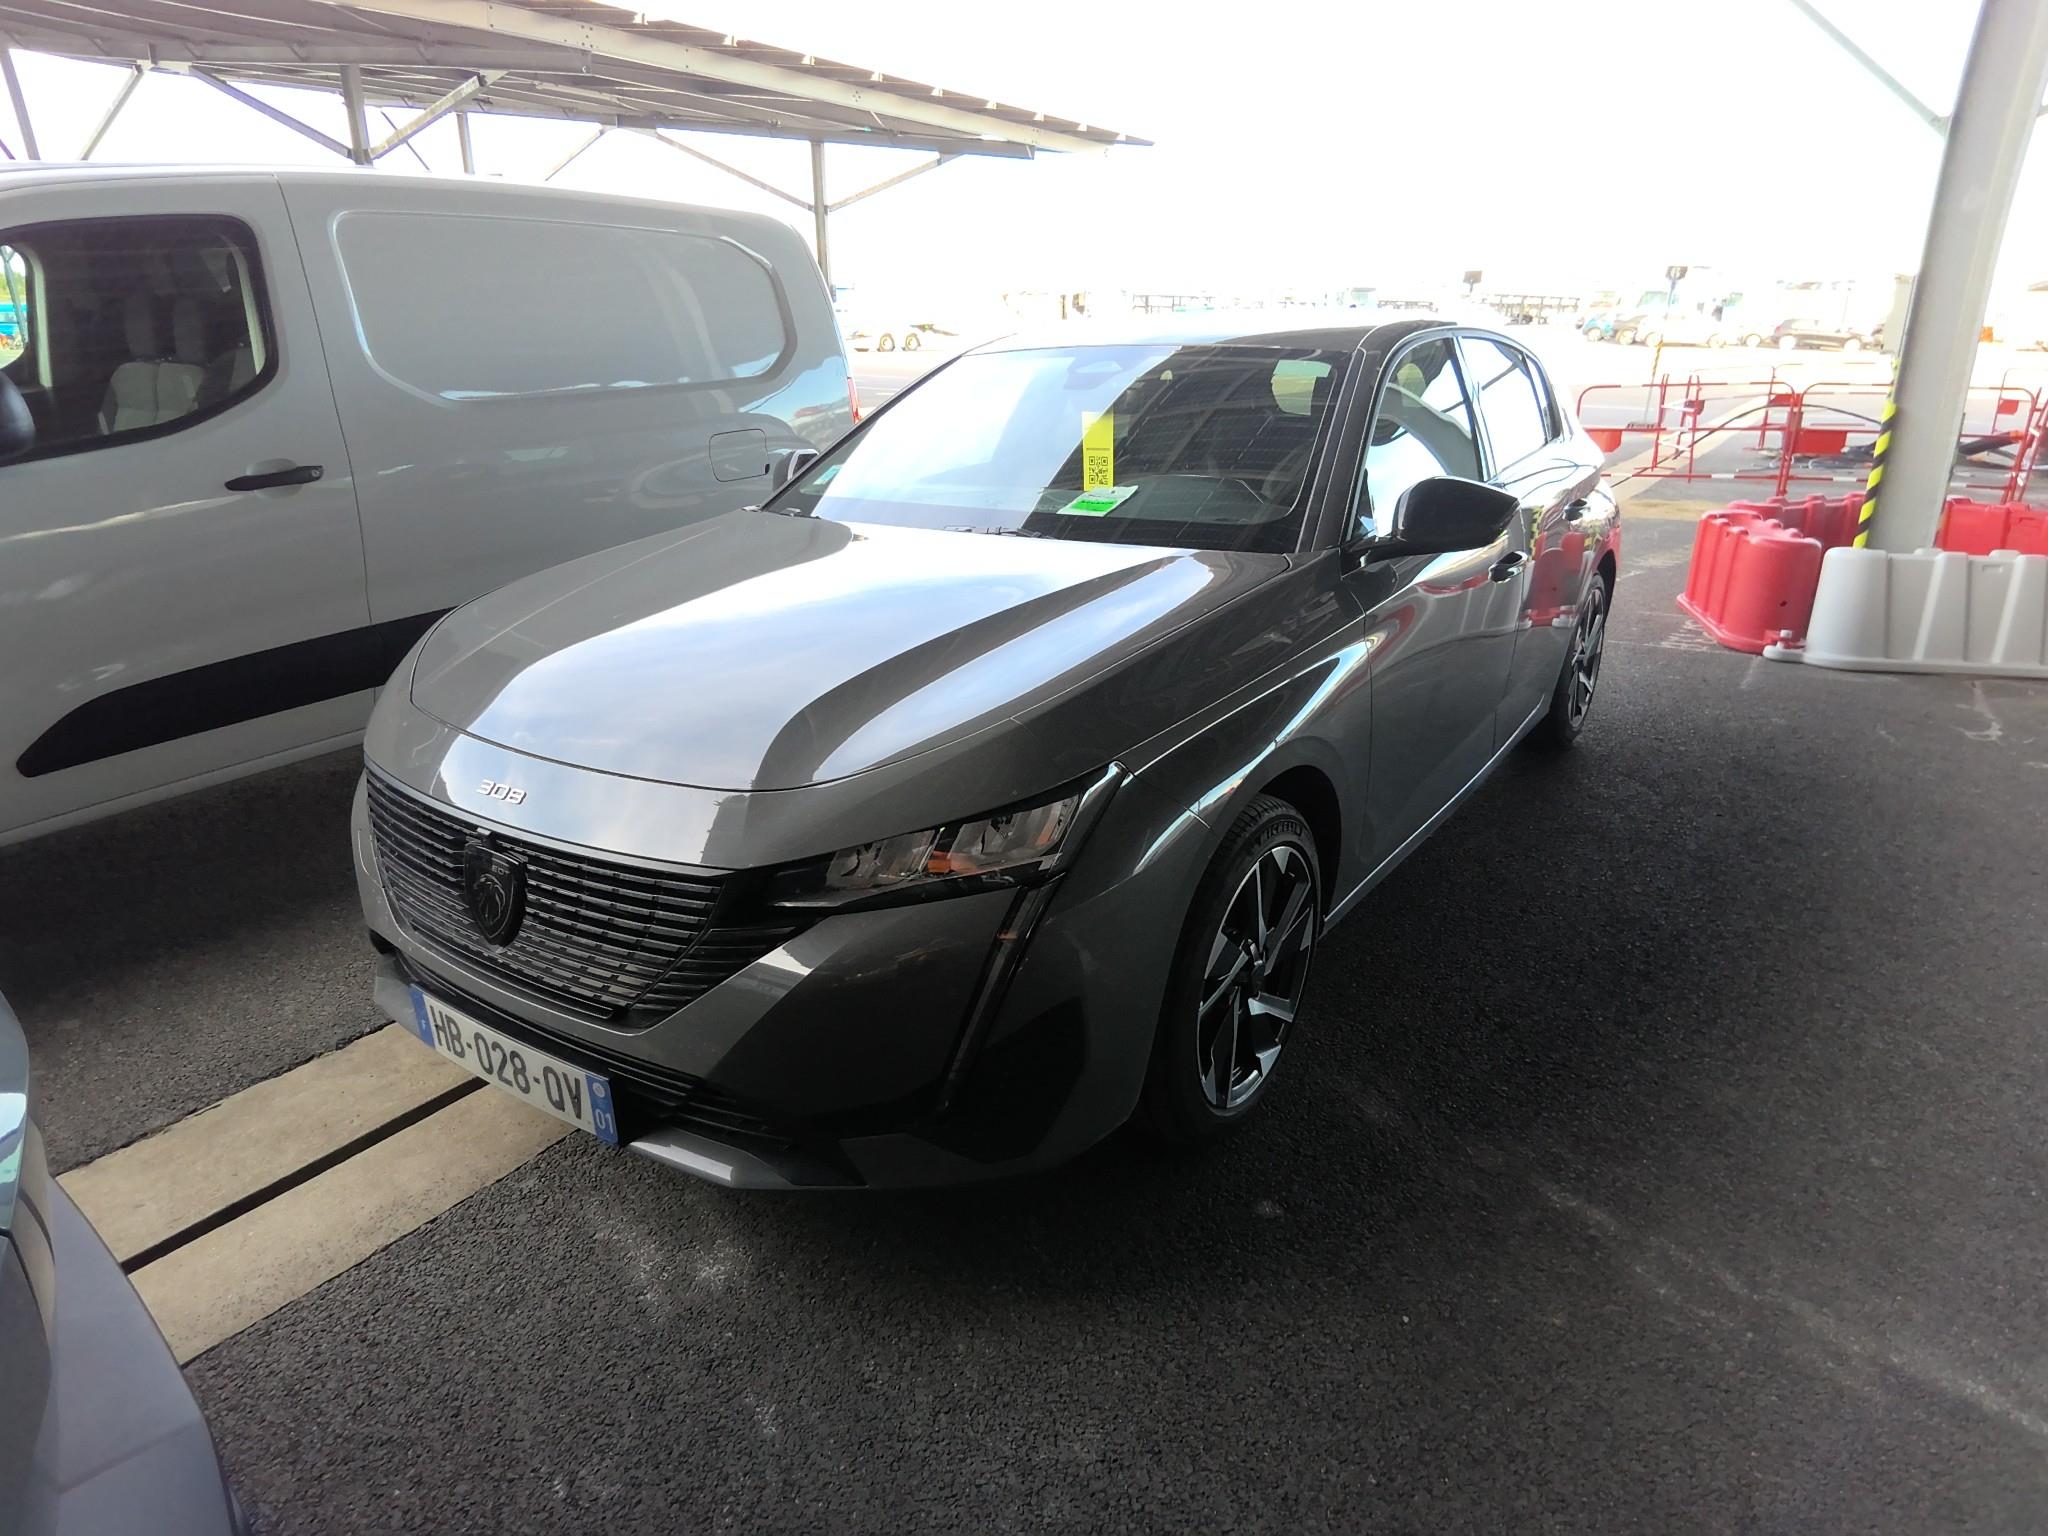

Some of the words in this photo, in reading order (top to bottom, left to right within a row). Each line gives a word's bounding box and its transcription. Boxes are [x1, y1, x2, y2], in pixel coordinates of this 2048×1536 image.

[476, 779, 527, 804] 308
[429, 1004, 582, 1120] HB-028-QV
[595, 1108, 614, 1134] 01
